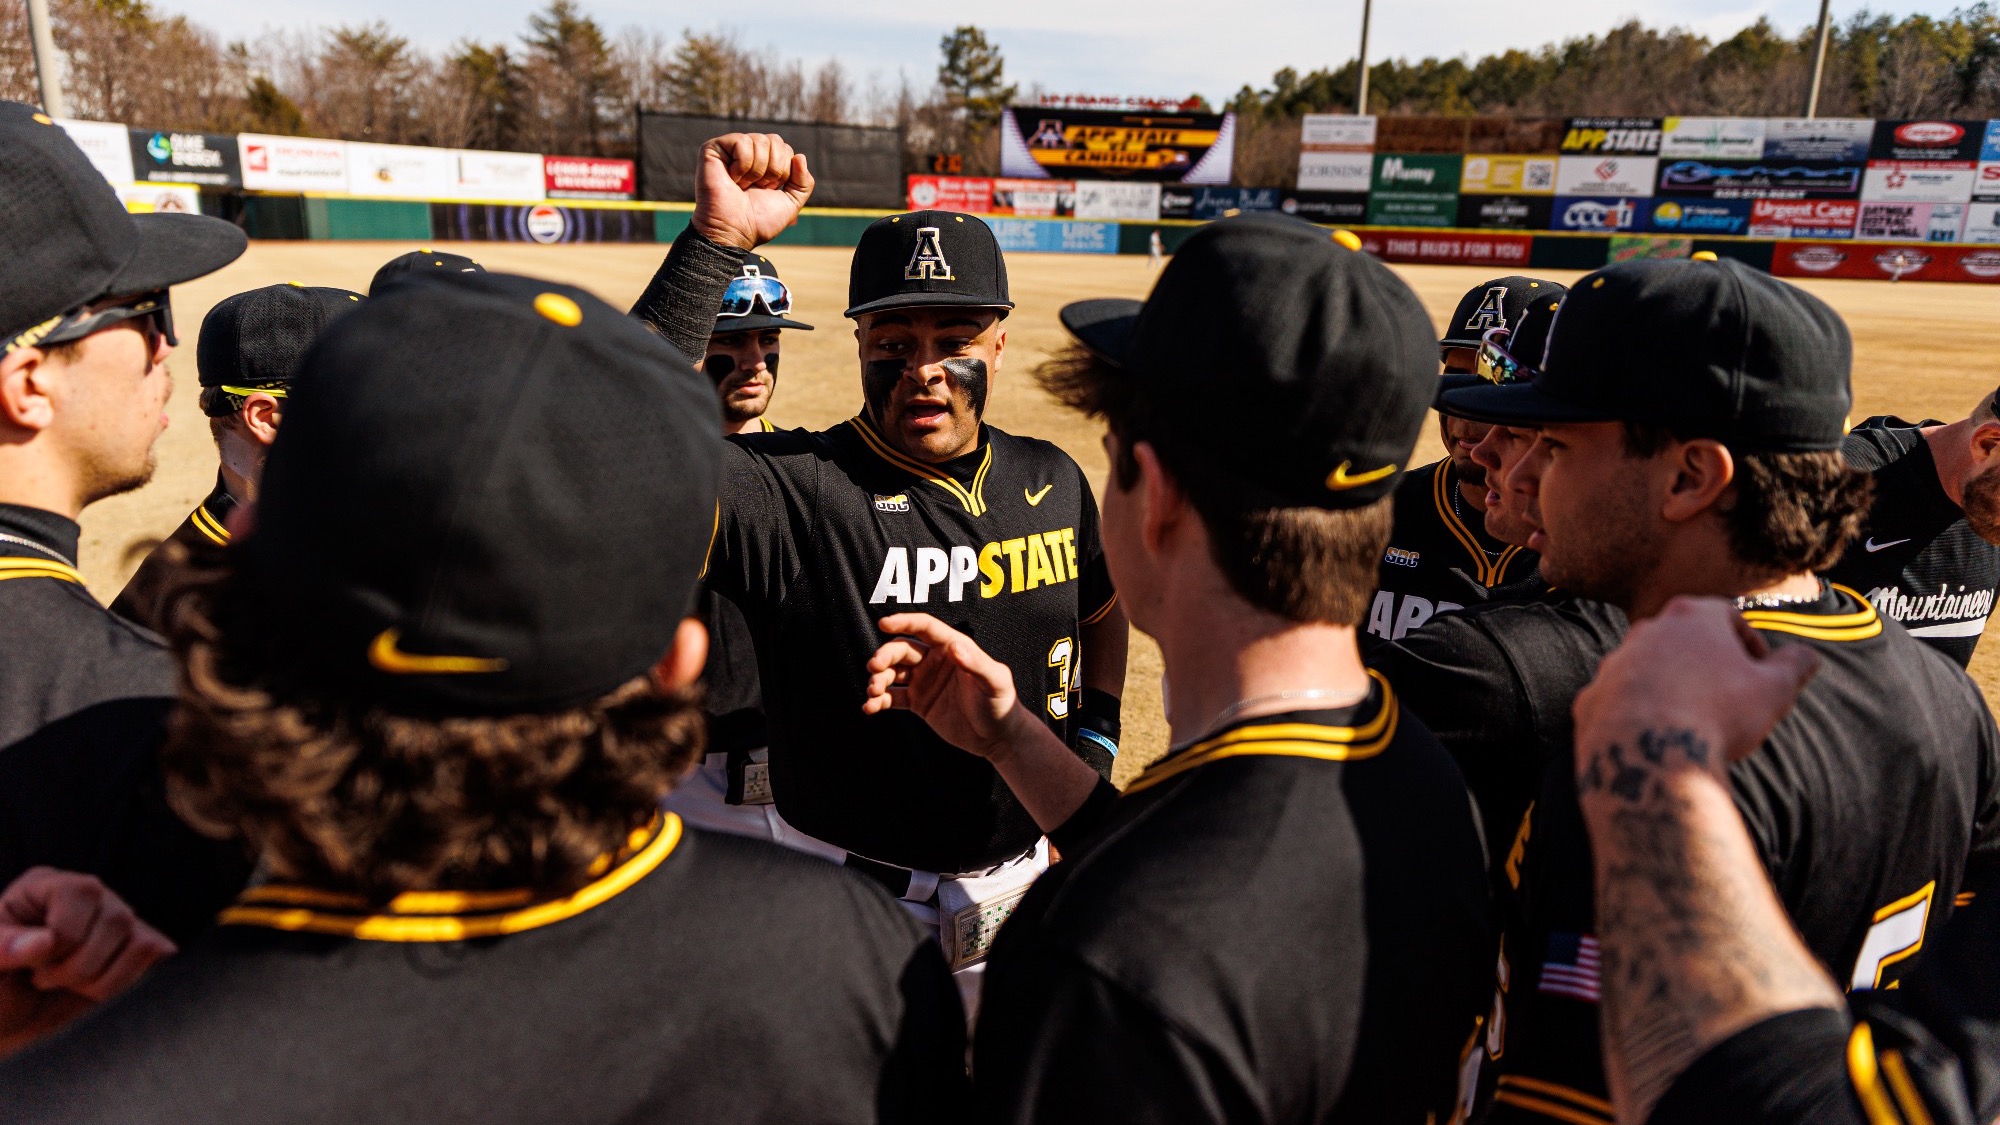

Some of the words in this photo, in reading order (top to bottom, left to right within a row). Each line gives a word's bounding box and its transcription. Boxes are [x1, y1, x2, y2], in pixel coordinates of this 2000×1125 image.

[1075, 129, 1116, 138] APP
[1125, 130, 1180, 141] STATE
[1561, 129, 1661, 150] APPSTATE
[1064, 151, 1148, 163] CANISIUS
[1754, 200, 1811, 219] Urgent
[1815, 201, 1856, 217] Care
[1681, 214, 1744, 232] Lottery
[905, 226, 951, 280] A
[1386, 239, 1417, 256] THIS
[1420, 240, 1460, 257] BUD'S
[1463, 242, 1491, 258] FOR
[1495, 242, 1525, 259] YOU
[1465, 286, 1509, 330] A
[1385, 546, 1420, 567] SBC
[1367, 590, 1466, 641] AP
